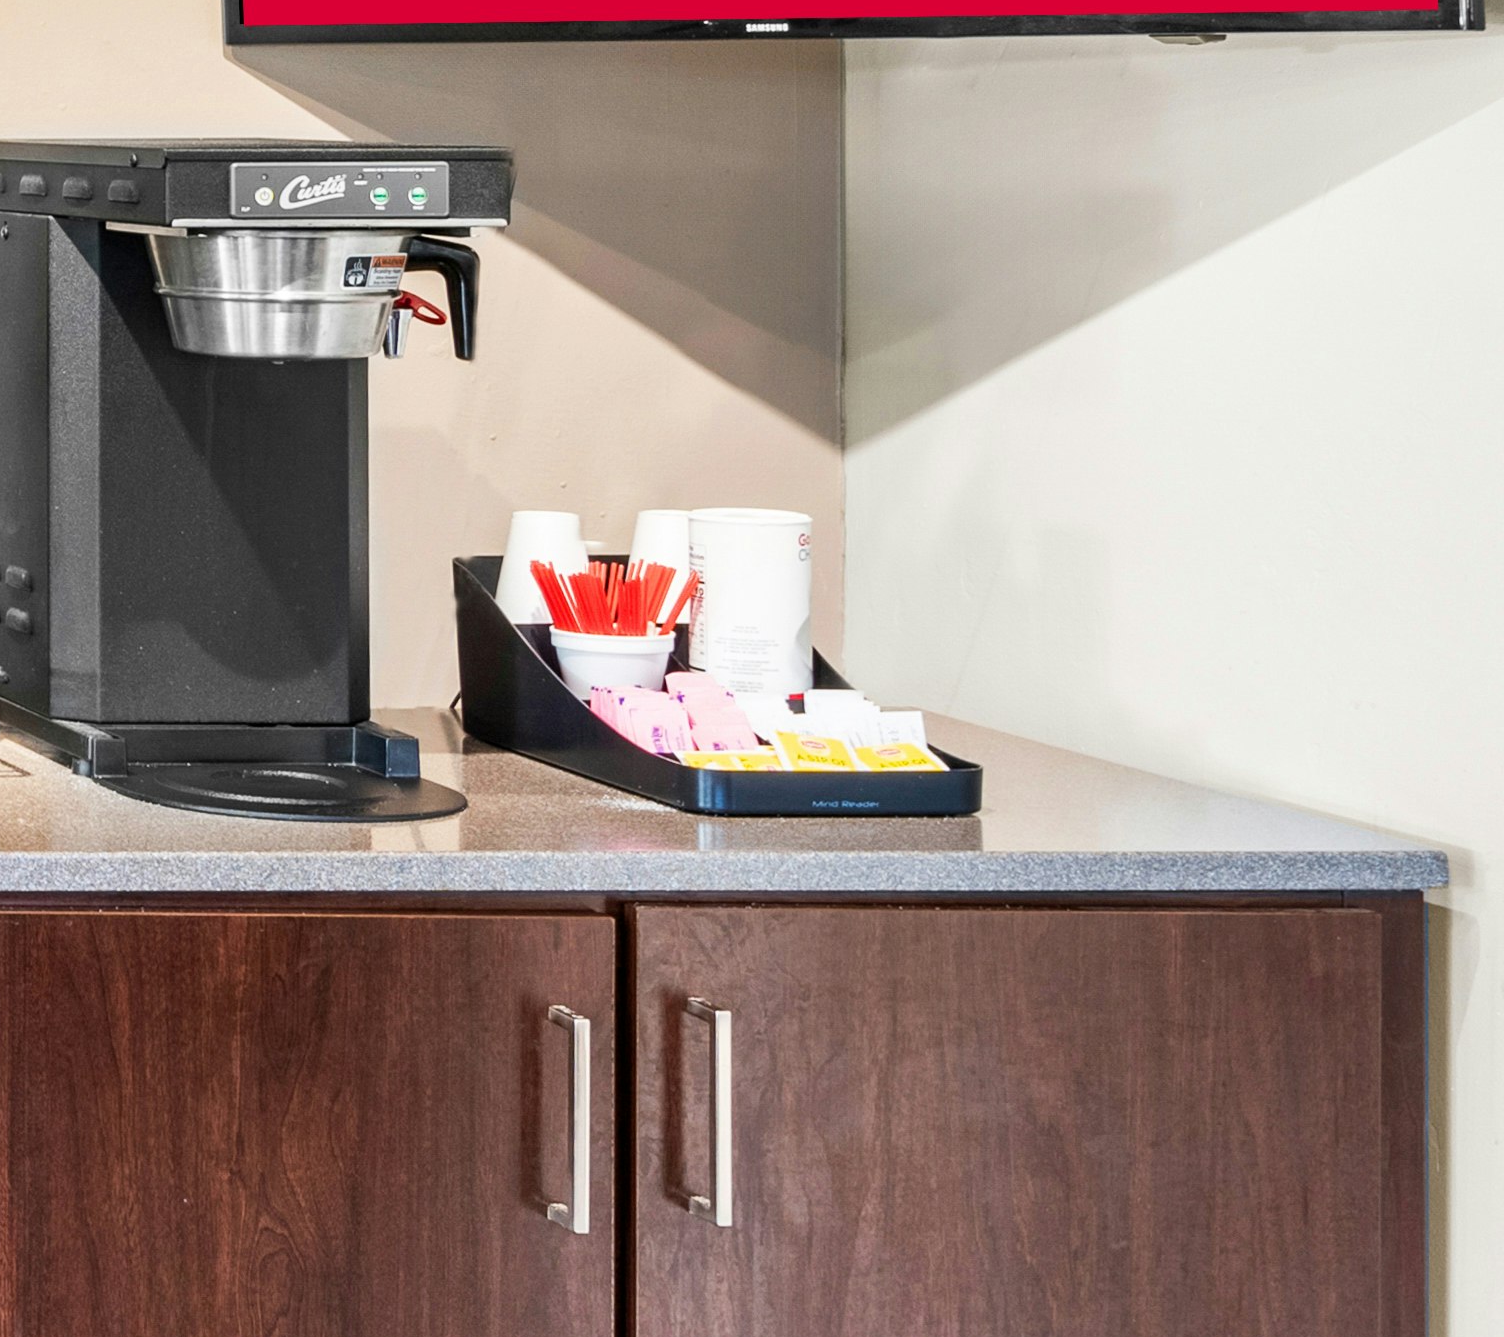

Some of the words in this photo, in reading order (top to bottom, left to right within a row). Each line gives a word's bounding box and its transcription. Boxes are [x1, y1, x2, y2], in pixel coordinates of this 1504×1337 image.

[279, 174, 346, 210] Curtis
[812, 800, 839, 808] Mind
[841, 800, 880, 808] Reader
